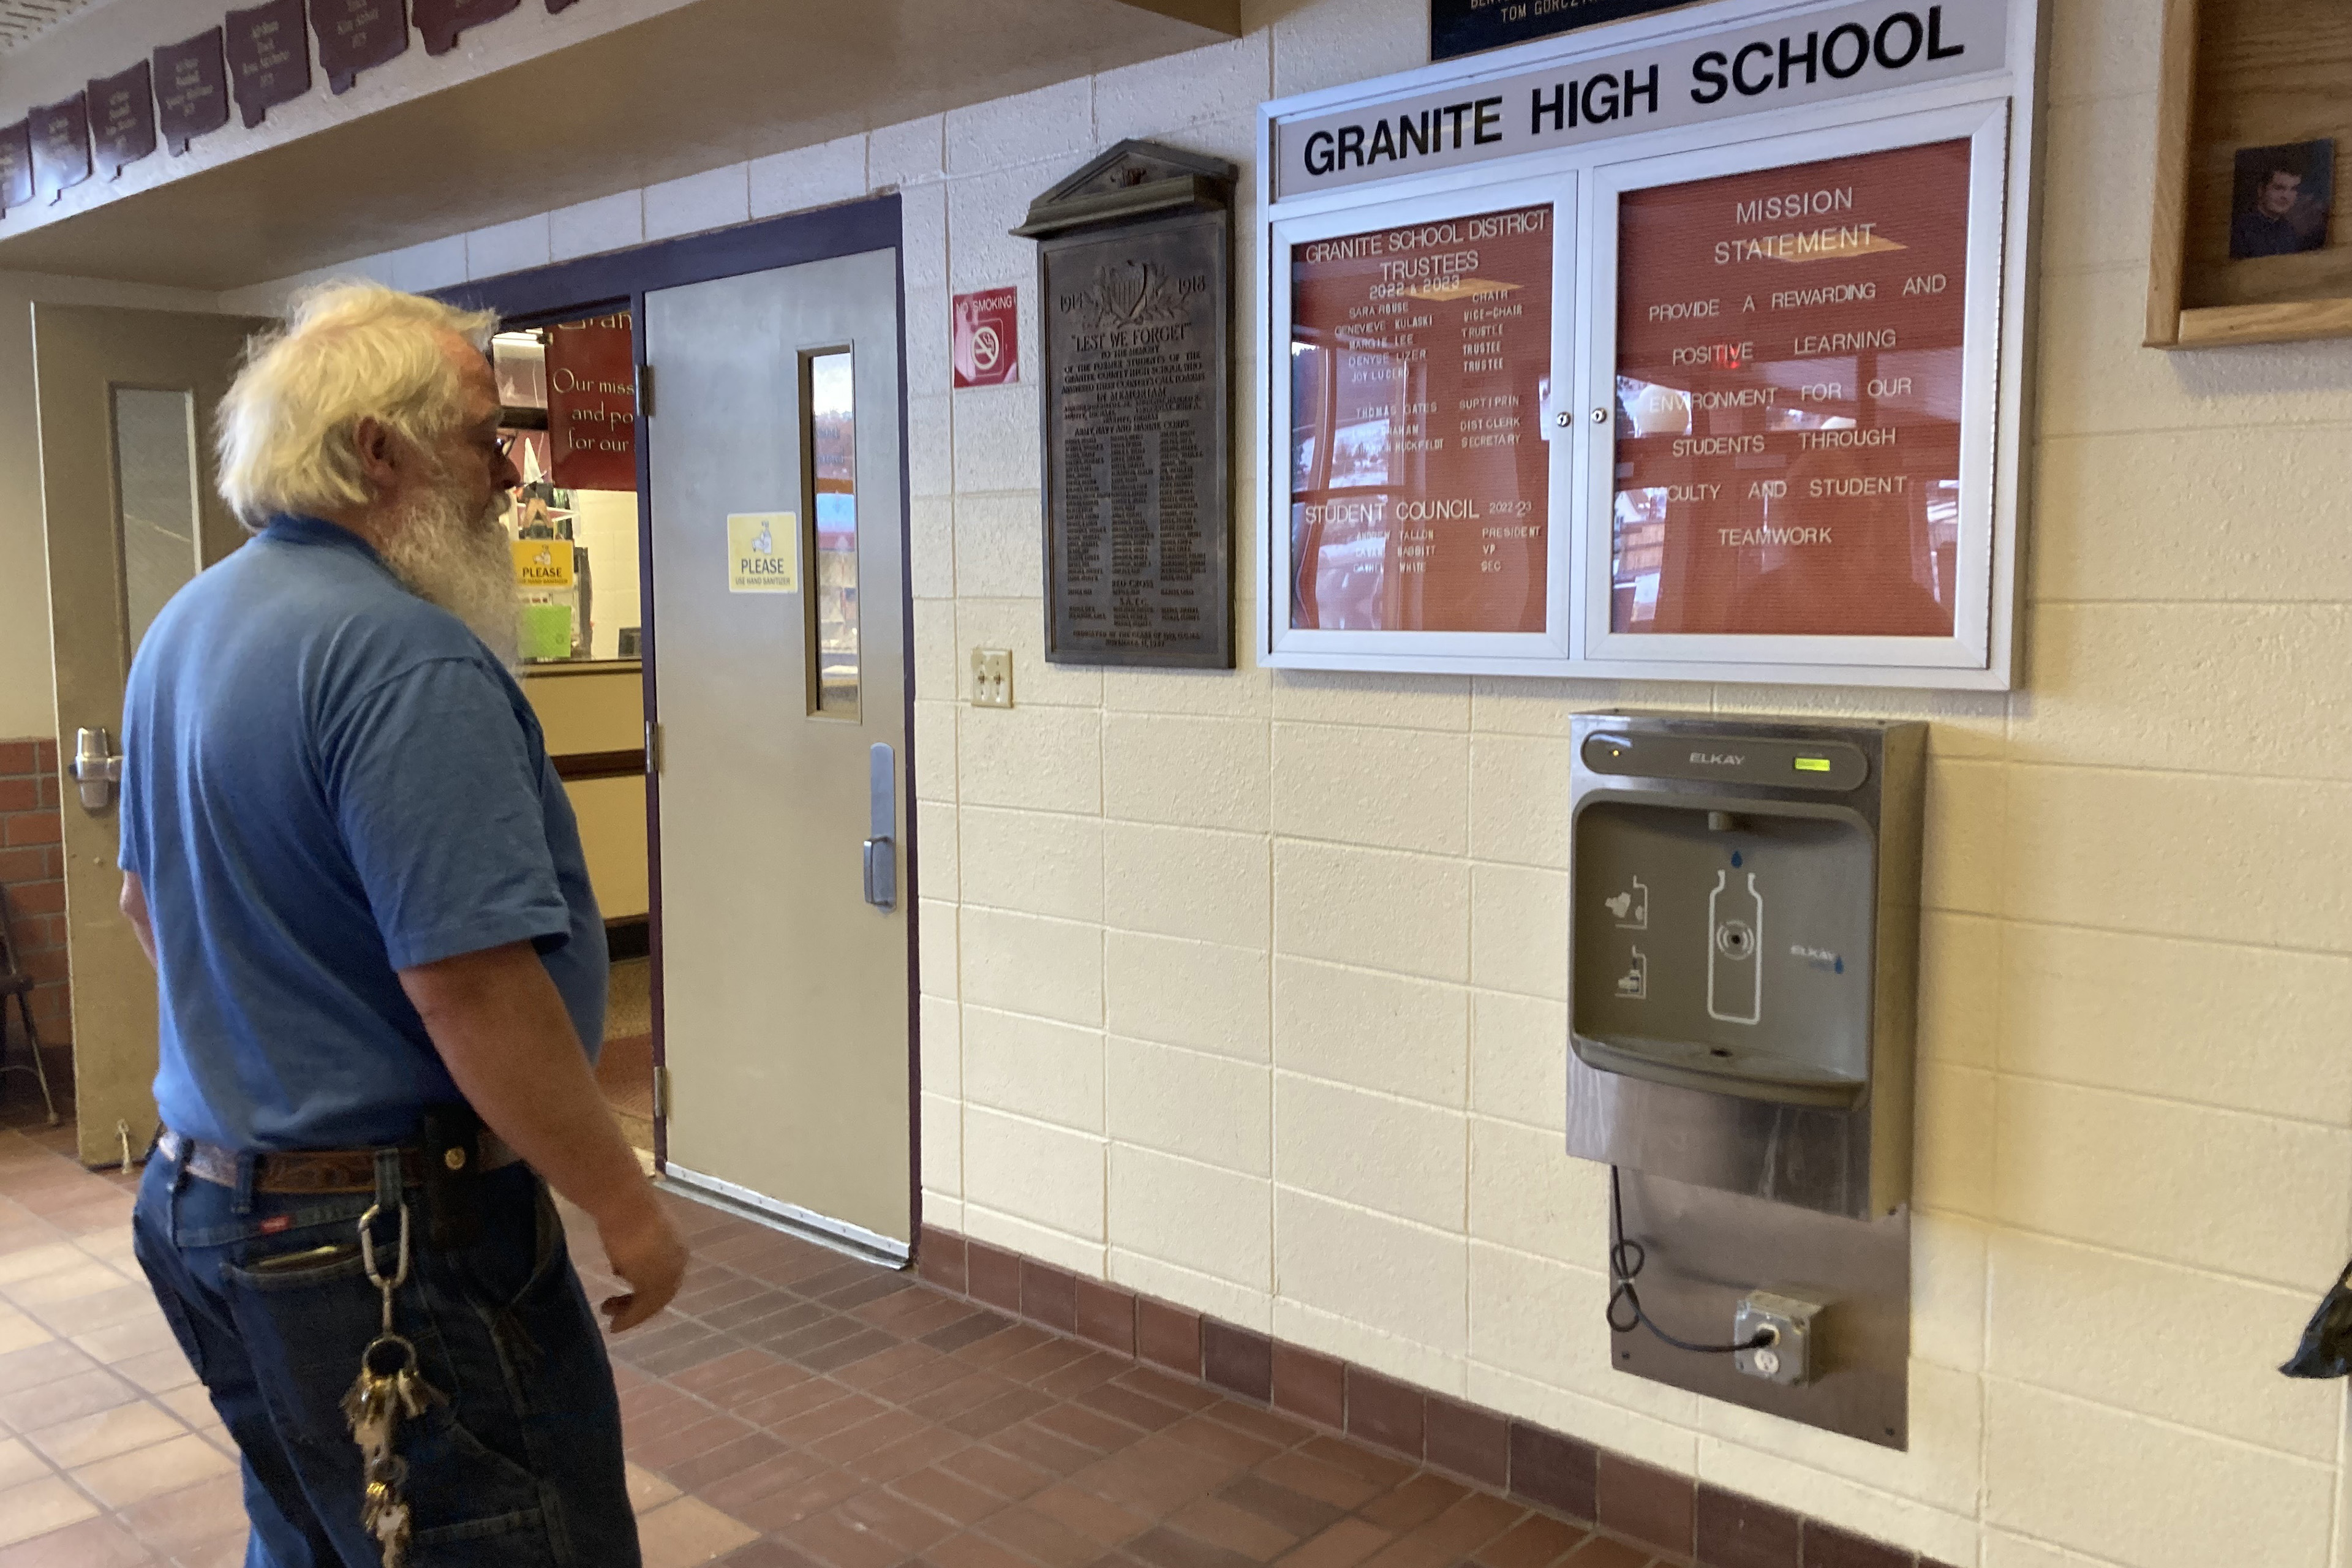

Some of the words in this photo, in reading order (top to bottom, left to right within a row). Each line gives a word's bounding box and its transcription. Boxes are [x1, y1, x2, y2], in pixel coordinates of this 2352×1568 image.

[1501, 4, 1526, 23] TOM
[1304, 96, 1503, 176] GRANITE
[1531, 64, 1659, 135] HIGH
[1691, 5, 1965, 104] SCHOOL
[1736, 186, 1853, 225] MISSION
[1306, 235, 1382, 264] GRANITE
[1389, 224, 1464, 252] SCHOOL
[1469, 209, 1550, 241] DISTRICT
[1714, 222, 1877, 265] STATEMENT
[1380, 250, 1479, 281] TRUSTEES
[1370, 282, 1404, 300] 2022
[1423, 275, 1461, 293] 2023
[1472, 290, 1508, 304] CHAIR
[956, 300, 969, 314] NO
[973, 295, 1012, 312] SMOKING
[1648, 298, 1721, 322] PROVIDE
[1743, 295, 1755, 313] A
[1771, 282, 1877, 309] REWARDING
[1902, 274, 1947, 296] AND
[1464, 304, 1522, 323] VICE-CHAIR
[1110, 331, 1128, 348] WE
[1395, 333, 1414, 347] LEE
[1462, 323, 1503, 339] TRUSTEE
[1463, 341, 1502, 356] TRUSTEE
[1672, 341, 1754, 366] POSITIVE
[1793, 329, 1897, 355] LEARNING
[1464, 357, 1503, 372] TRUSTEE
[553, 368, 595, 393] Our
[1649, 387, 1778, 413] ENVRONMENT
[1801, 382, 1842, 402] FOR
[1867, 377, 1912, 398] OUR
[572, 400, 605, 422] and
[1460, 419, 1483, 432] DIST
[569, 426, 595, 450] for
[600, 437, 630, 452] our
[1461, 434, 1521, 449] SECRETARY
[1672, 434, 1765, 458] STUDENTS
[1798, 428, 1897, 451] THROUGH
[1667, 483, 1722, 502] CULTY
[1748, 480, 1787, 500] AND
[1809, 475, 1907, 497] STUDENT
[1305, 502, 1387, 524] STUDENT
[1396, 499, 1480, 521] COUNCIL
[1482, 526, 1541, 539] PRESIDENT
[1718, 526, 1833, 546] TEAMWORK
[1483, 543, 1495, 555] VP
[522, 567, 562, 578] PLEASE
[741, 558, 784, 574] PLEASE
[747, 576, 762, 585] HAND
[763, 576, 791, 586] SANITIZER
[1689, 752, 1745, 766] ELKAY
